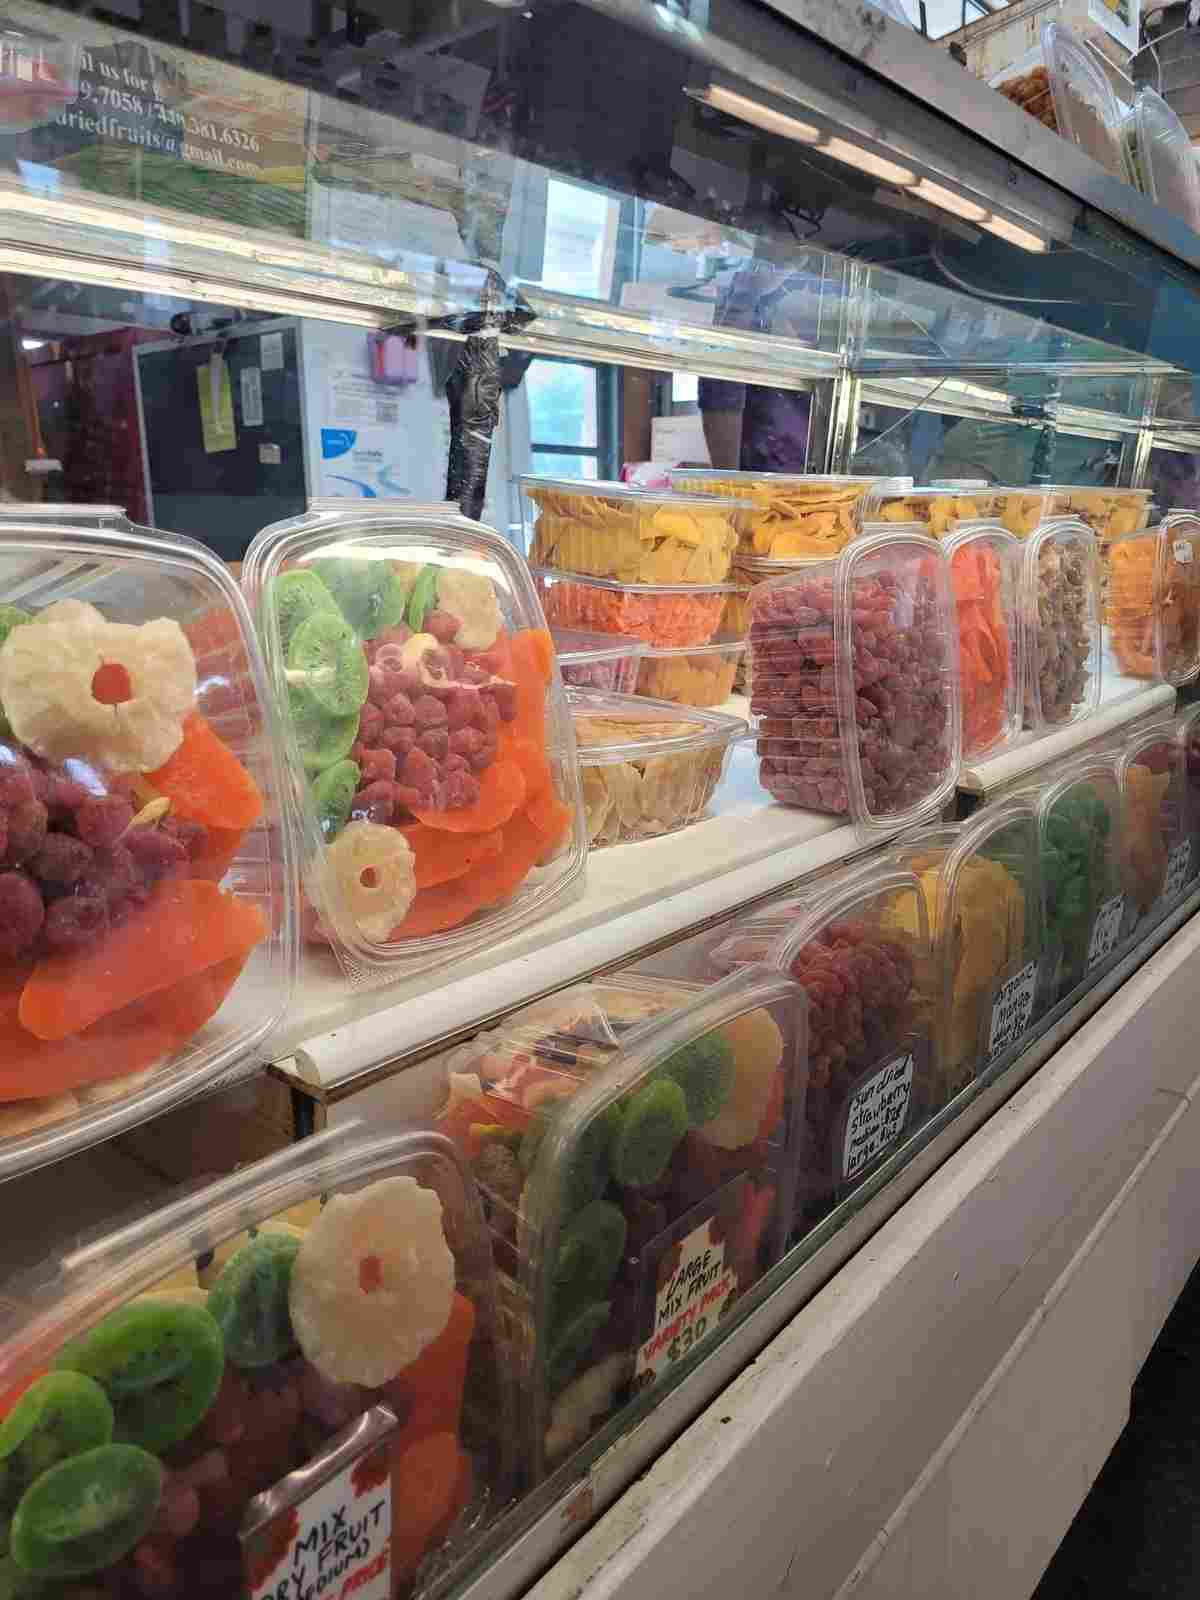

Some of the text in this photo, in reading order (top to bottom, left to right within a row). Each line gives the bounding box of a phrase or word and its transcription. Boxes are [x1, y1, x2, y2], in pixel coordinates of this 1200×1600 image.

[99, 62, 120, 80] us
[656, 1261, 721, 1325] MIX FRUIT
[666, 1249, 711, 1302] LARGE
[292, 1504, 346, 1567] MIX
[318, 1498, 386, 1572] FRUIT
